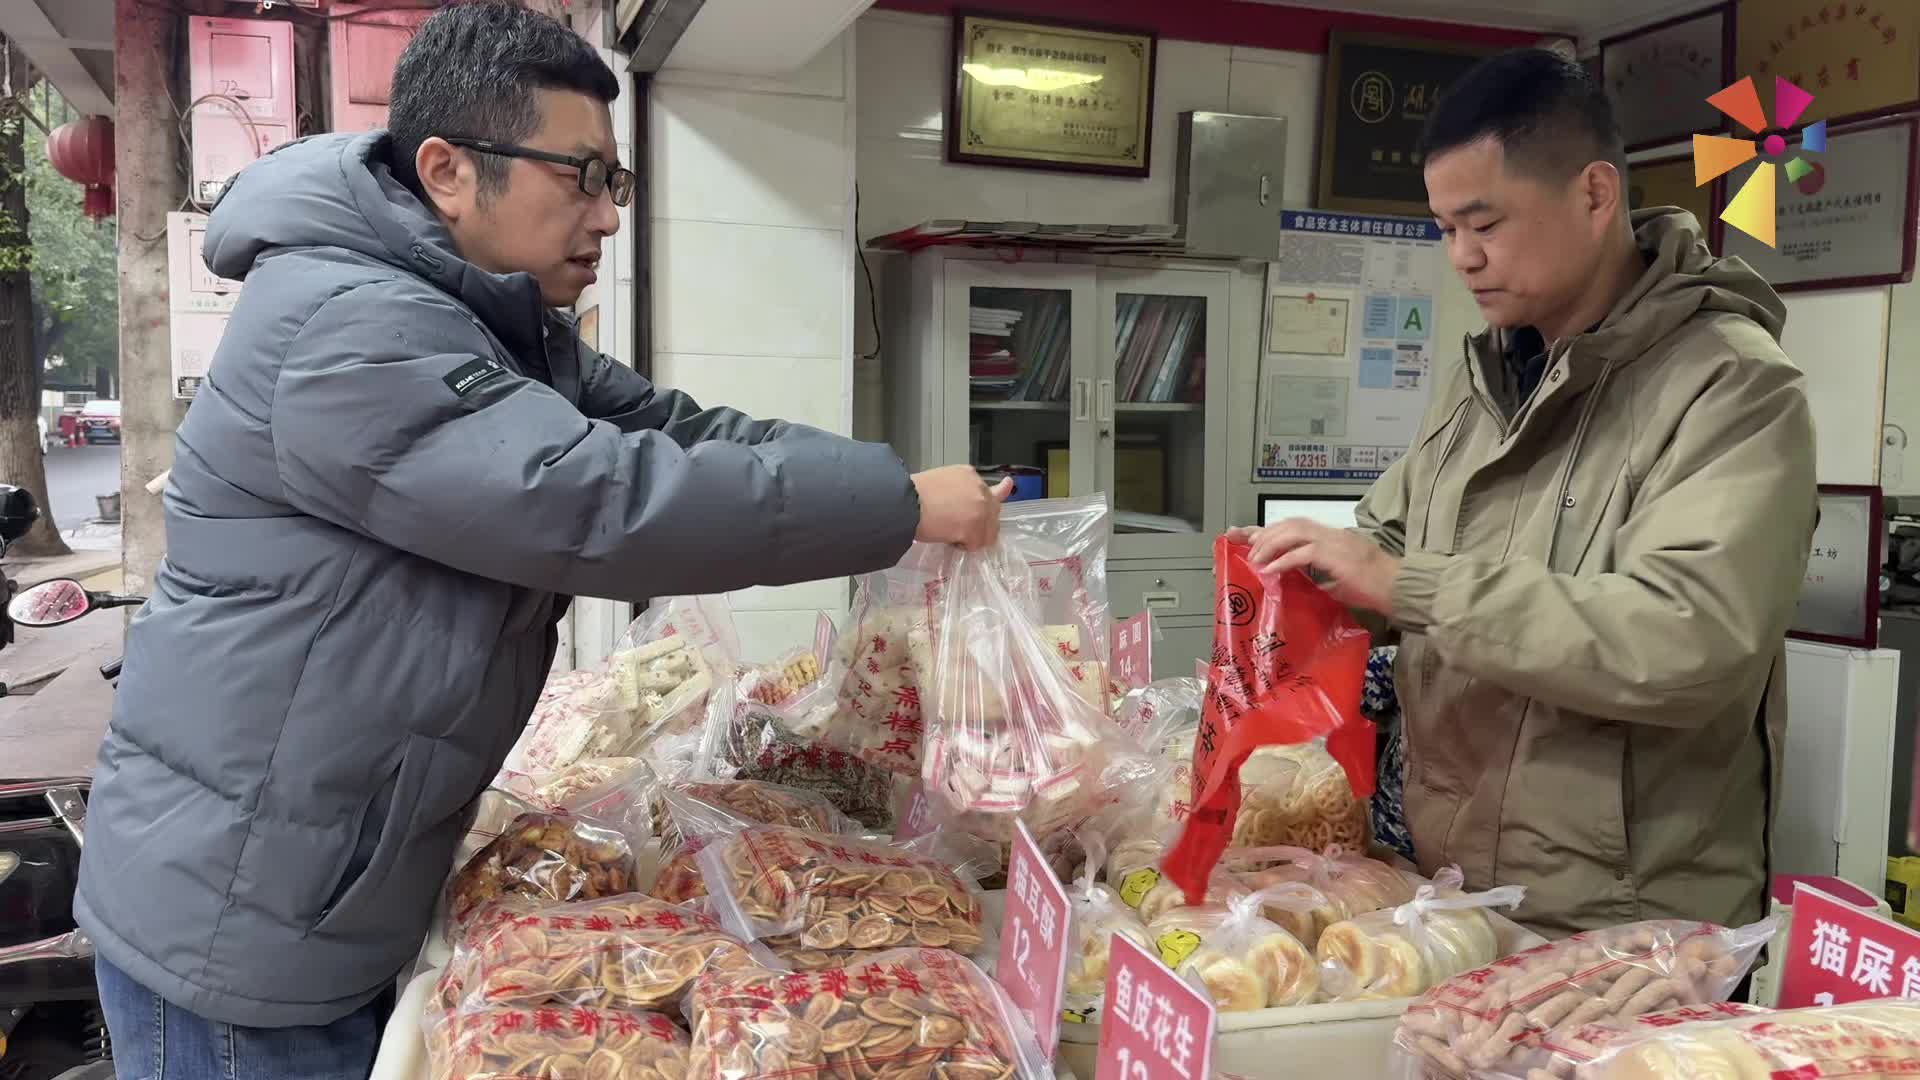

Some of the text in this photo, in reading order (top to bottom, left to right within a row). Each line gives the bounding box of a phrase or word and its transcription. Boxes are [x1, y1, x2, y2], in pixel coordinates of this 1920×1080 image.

[1295, 215, 1426, 238] 食品安全主体责任信息公示
[1404, 307, 1423, 331] A
[1295, 453, 1327, 468] 12315
[1012, 915, 1031, 982] 12
[1113, 964, 1193, 1080] 鱼皮花生
